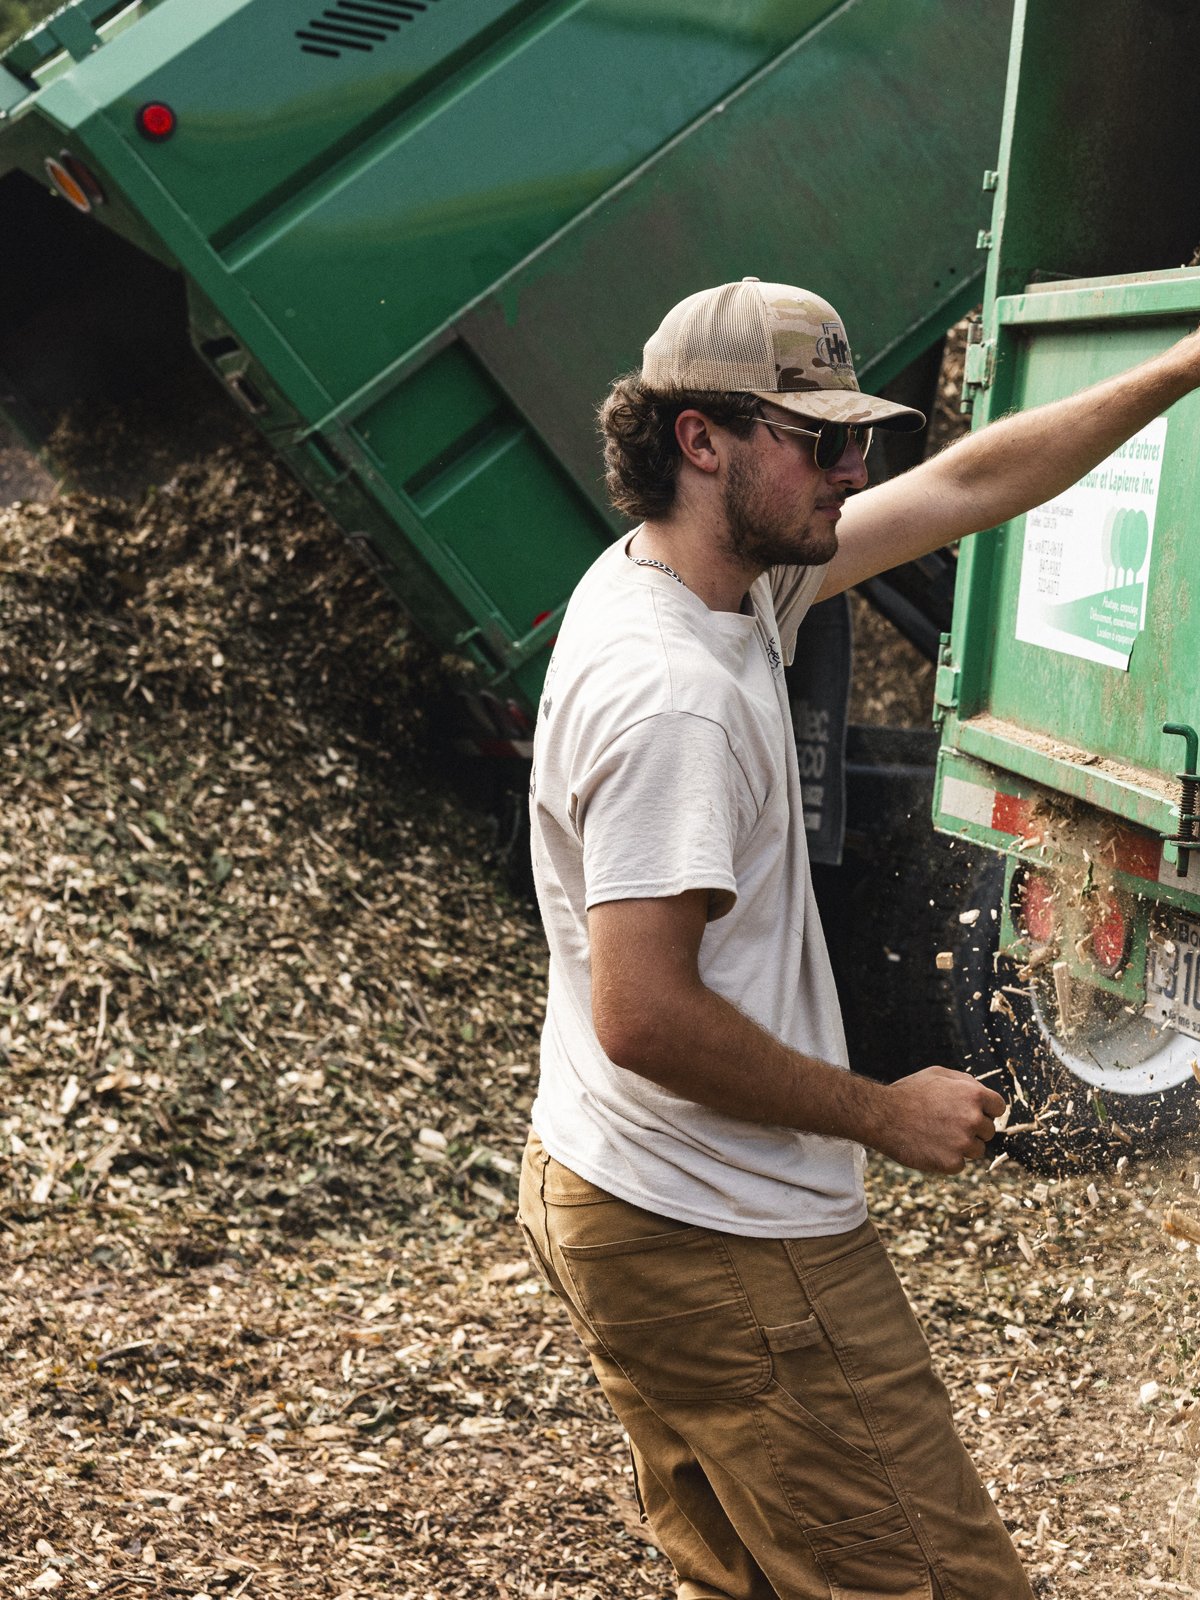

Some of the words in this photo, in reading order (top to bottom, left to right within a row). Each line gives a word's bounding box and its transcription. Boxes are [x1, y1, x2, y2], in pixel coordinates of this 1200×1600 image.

[1128, 438, 1161, 461] d'arbres
[1100, 471, 1108, 489] et
[1109, 469, 1140, 496] Lapierre
[1141, 472, 1155, 495] inc.
